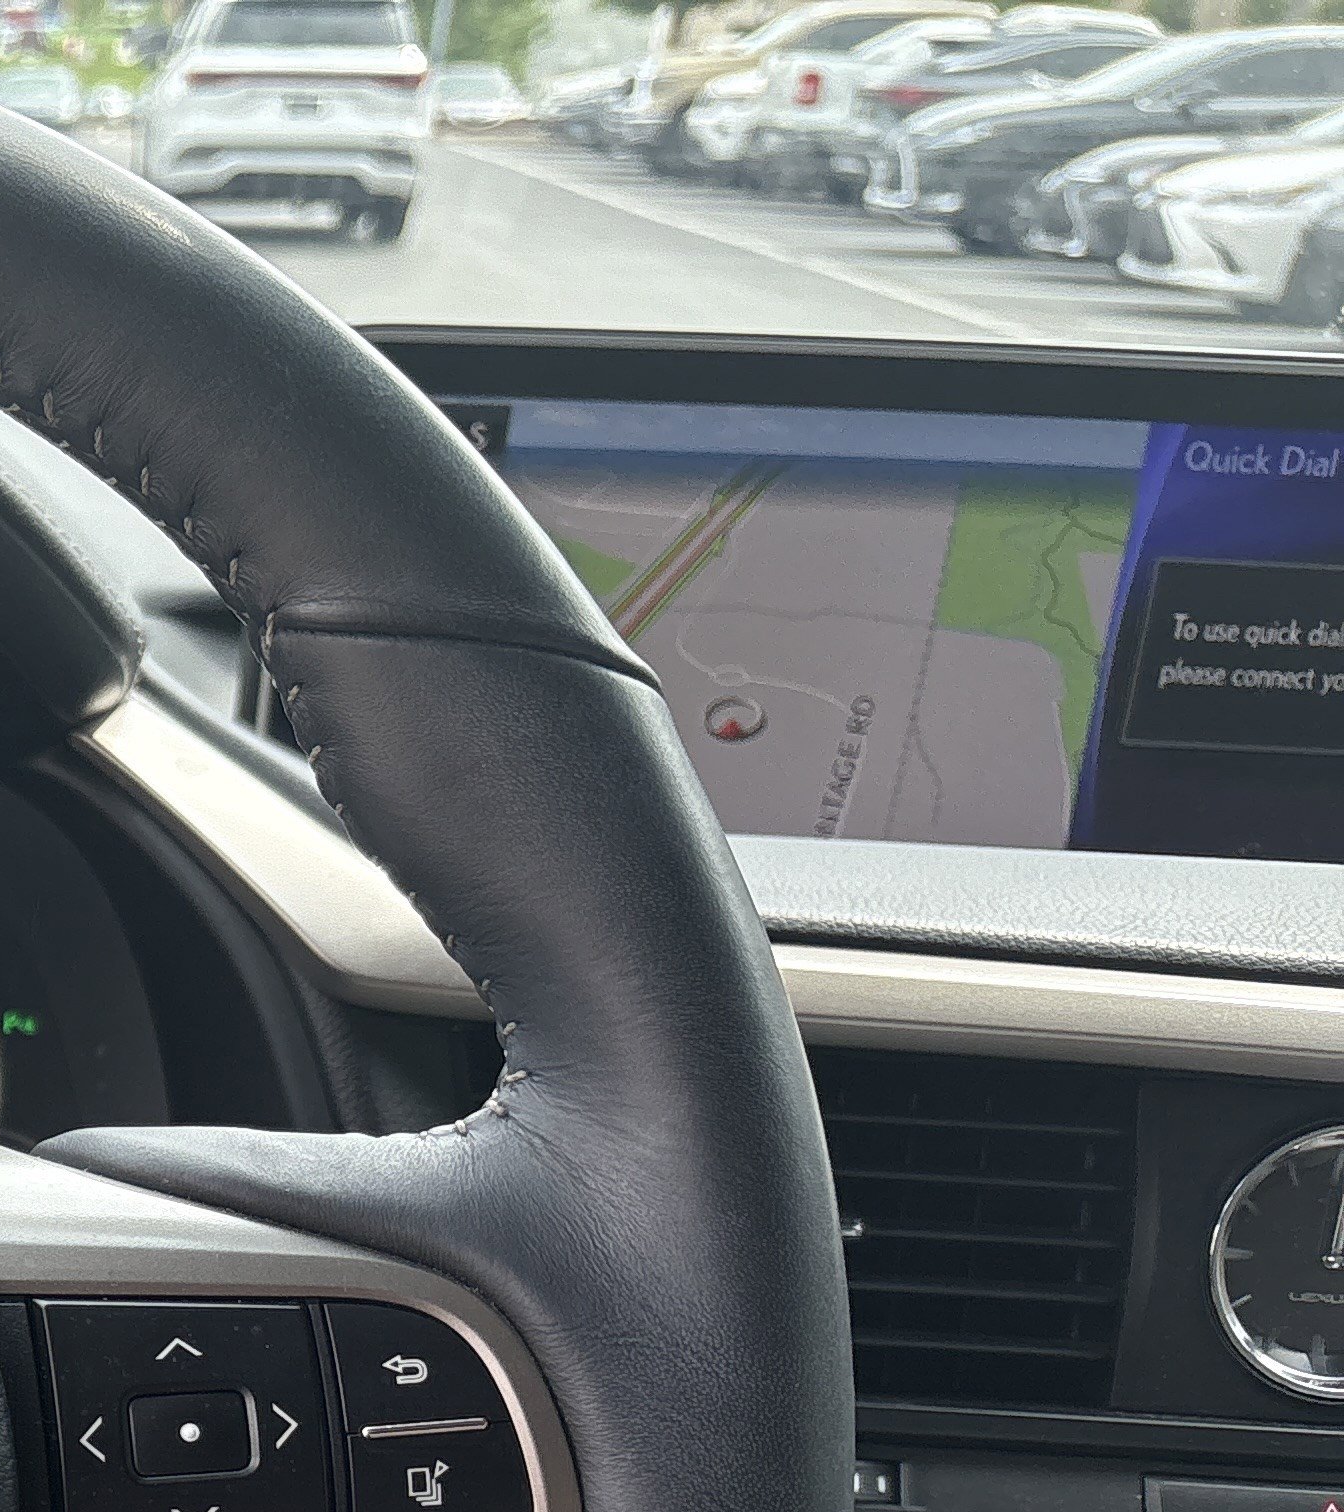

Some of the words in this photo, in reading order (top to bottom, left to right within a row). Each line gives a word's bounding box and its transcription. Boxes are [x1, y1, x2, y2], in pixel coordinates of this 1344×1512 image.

[1184, 440, 1272, 475] Quick
[1280, 445, 1341, 478] Dial
[1173, 612, 1198, 642] To
[1202, 622, 1240, 643] use
[1243, 618, 1302, 648] quick
[1158, 657, 1227, 690] please
[1231, 667, 1315, 690] connect
